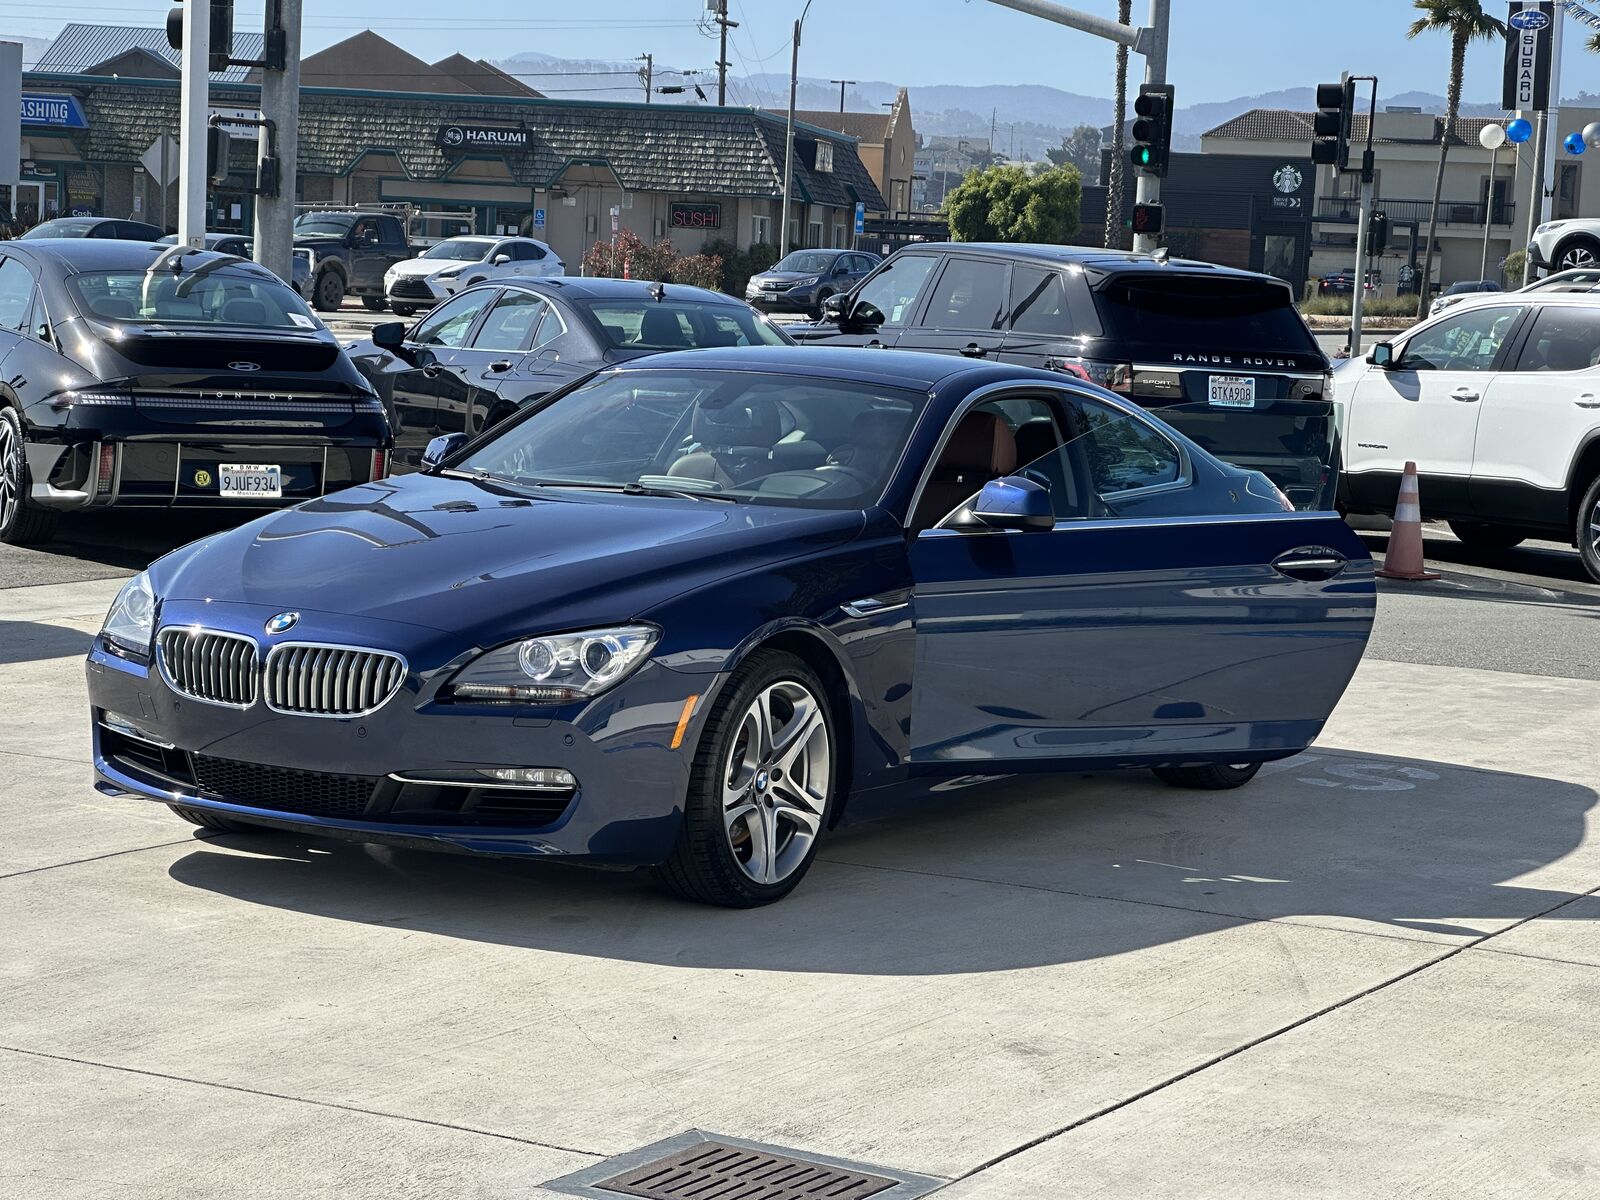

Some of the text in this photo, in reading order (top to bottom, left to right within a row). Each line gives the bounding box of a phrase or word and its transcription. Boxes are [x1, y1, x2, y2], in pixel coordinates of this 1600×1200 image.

[1520, 35, 1534, 102] SUBARU
[466, 130, 527, 143] HARUMI
[71, 209, 92, 217] Cash
[673, 211, 718, 227] SUSHI
[1173, 353, 1296, 367] RANGE ROVER
[1211, 386, 1251, 401] 8TKA908
[197, 474, 208, 482] EV
[223, 475, 276, 491] 9JUF934
